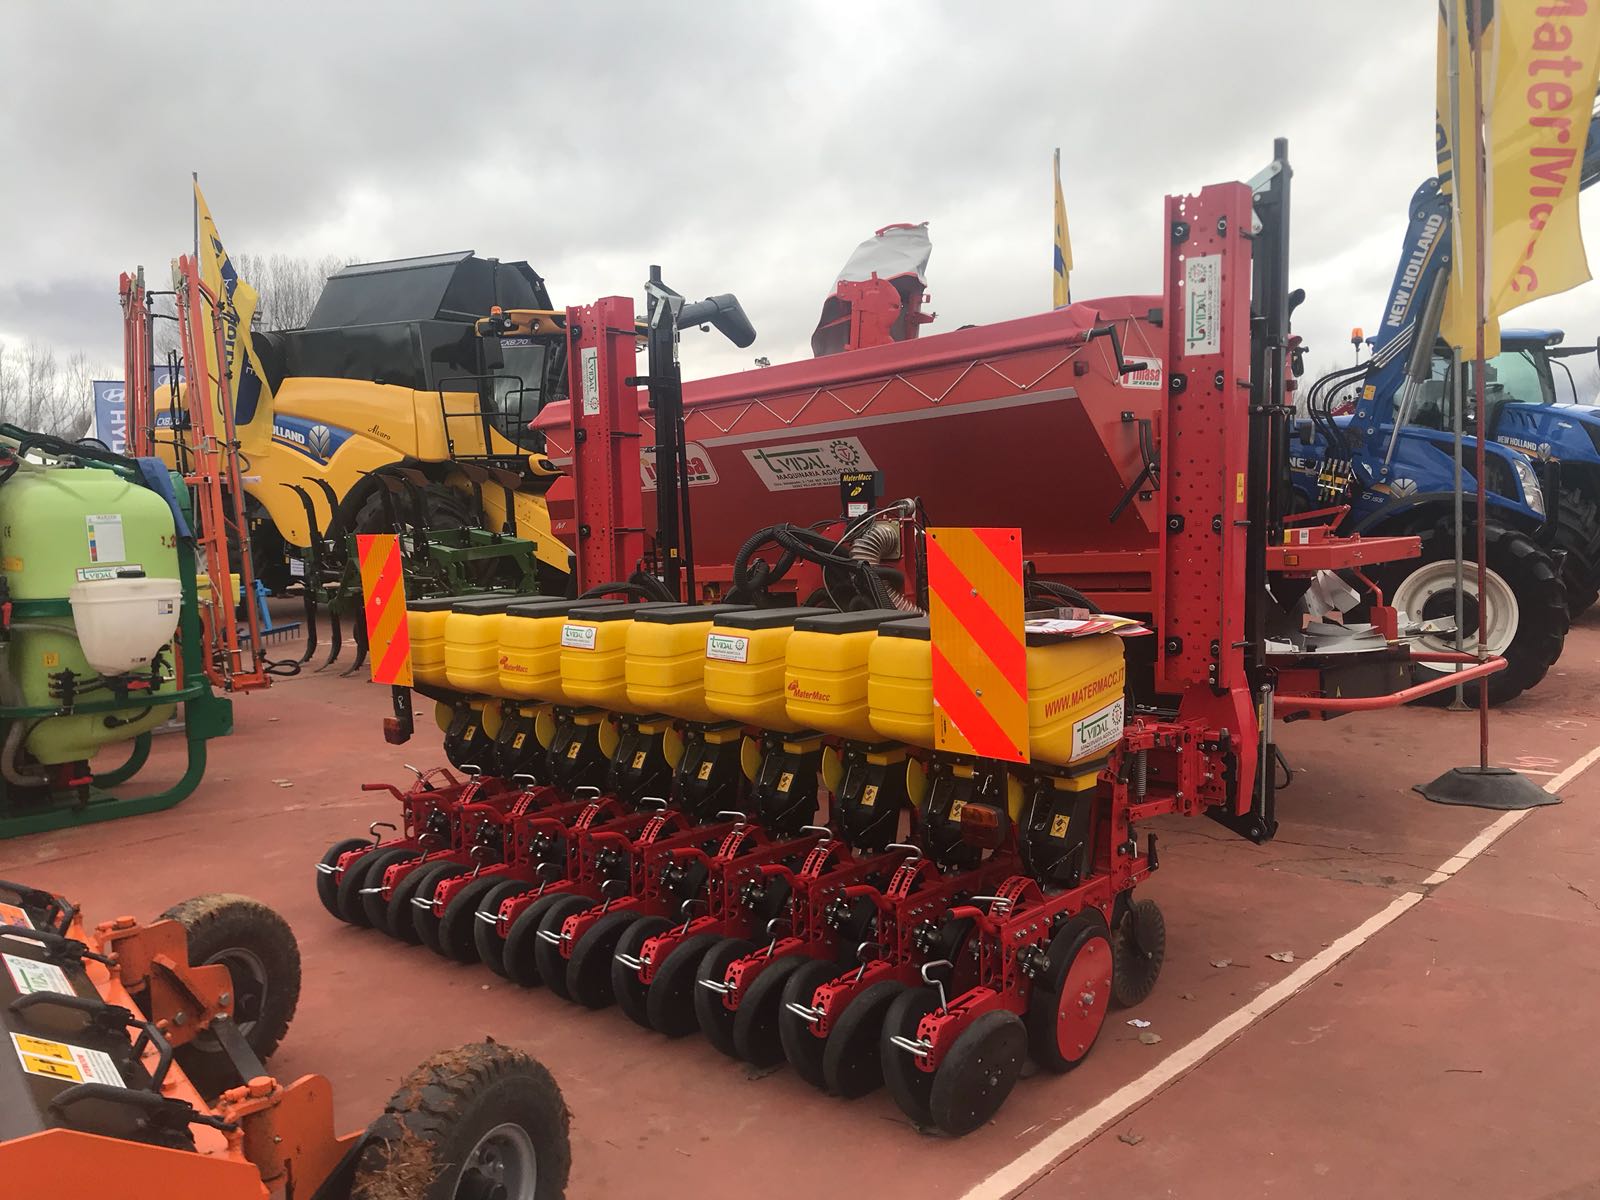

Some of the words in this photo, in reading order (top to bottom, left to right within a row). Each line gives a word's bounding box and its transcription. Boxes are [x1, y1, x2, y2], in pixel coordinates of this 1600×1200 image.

[1386, 289, 1410, 327] NEW
[1400, 214, 1443, 289] HOLLAND
[1498, 436, 1510, 444] NEW
[1510, 437, 1537, 451] HOLLAND
[776, 471, 820, 480] MAQUINARIA
[842, 473, 872, 482] MaterMacc
[793, 689, 830, 701] MaterMacc
[1045, 667, 1124, 718] WWW.MATERMACC.IT
